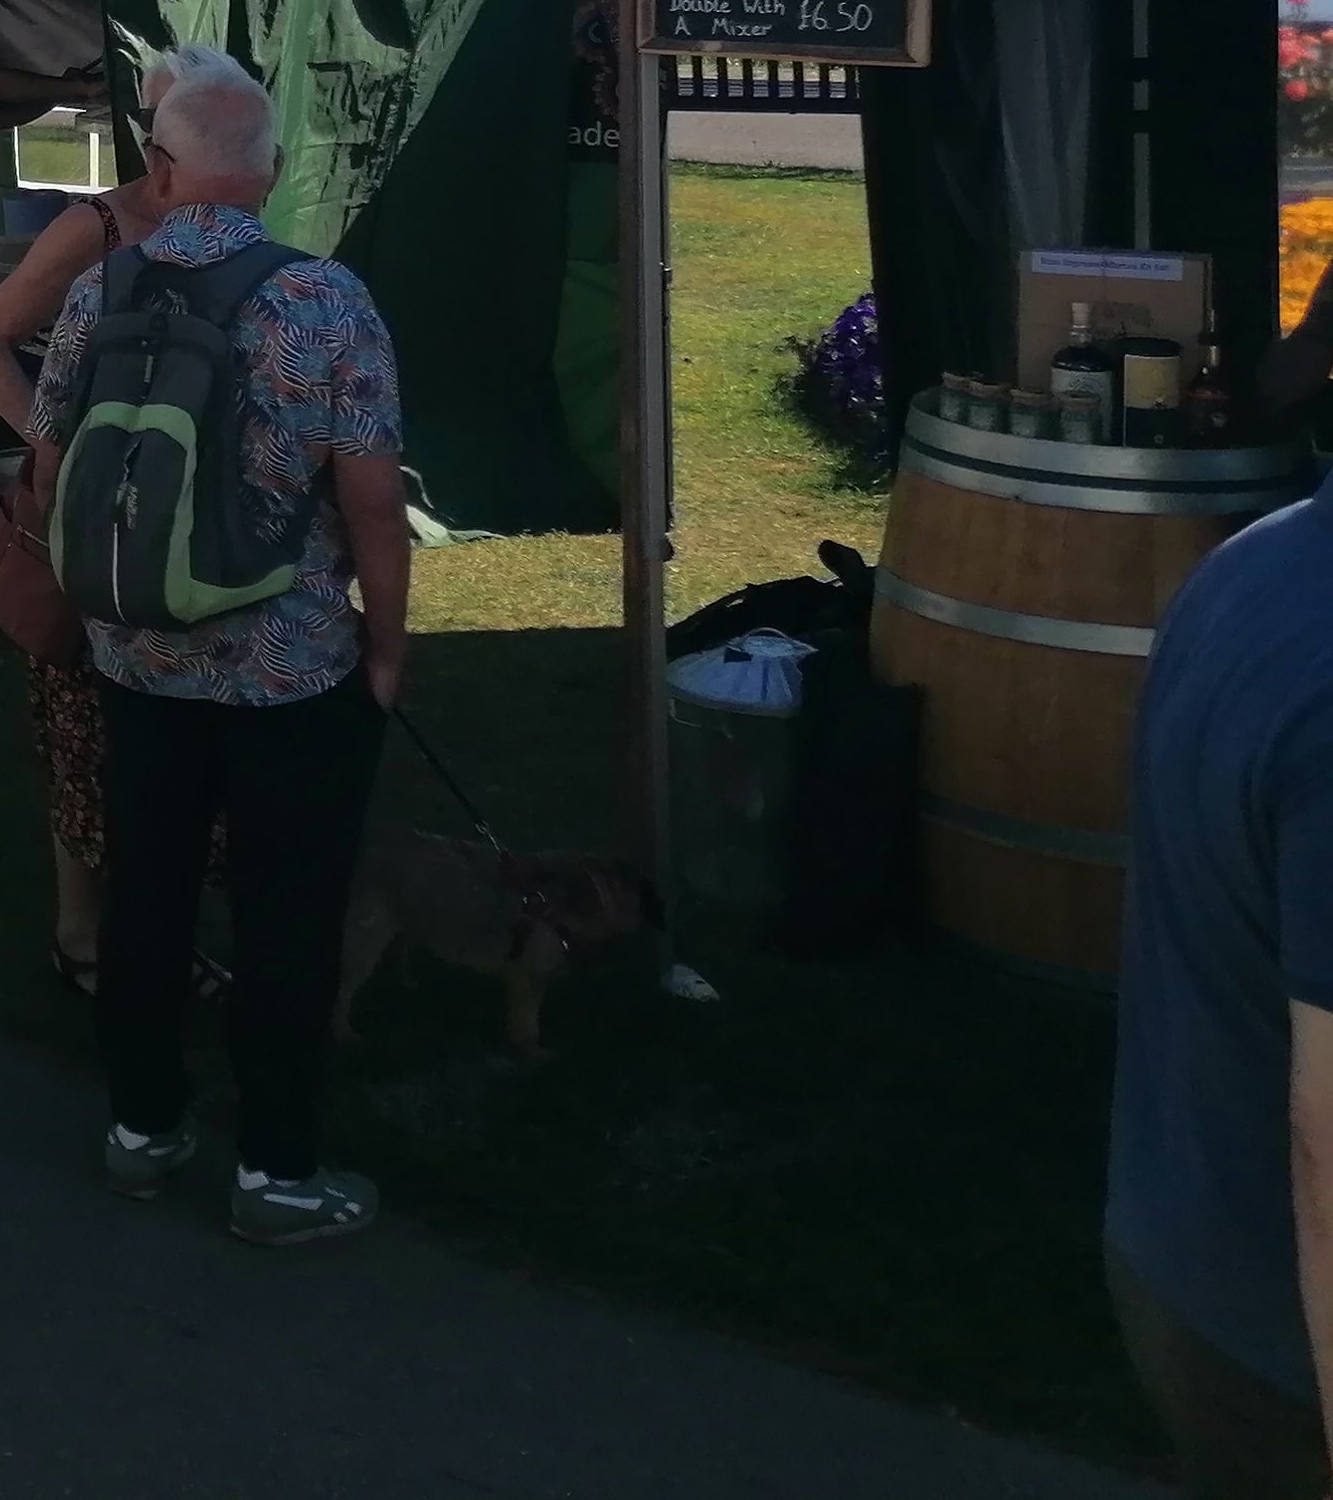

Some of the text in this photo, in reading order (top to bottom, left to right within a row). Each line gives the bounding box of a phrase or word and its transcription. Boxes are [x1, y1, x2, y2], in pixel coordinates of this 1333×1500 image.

[674, 16, 772, 37] A Mixer
[798, 0, 872, 32] £6.50
